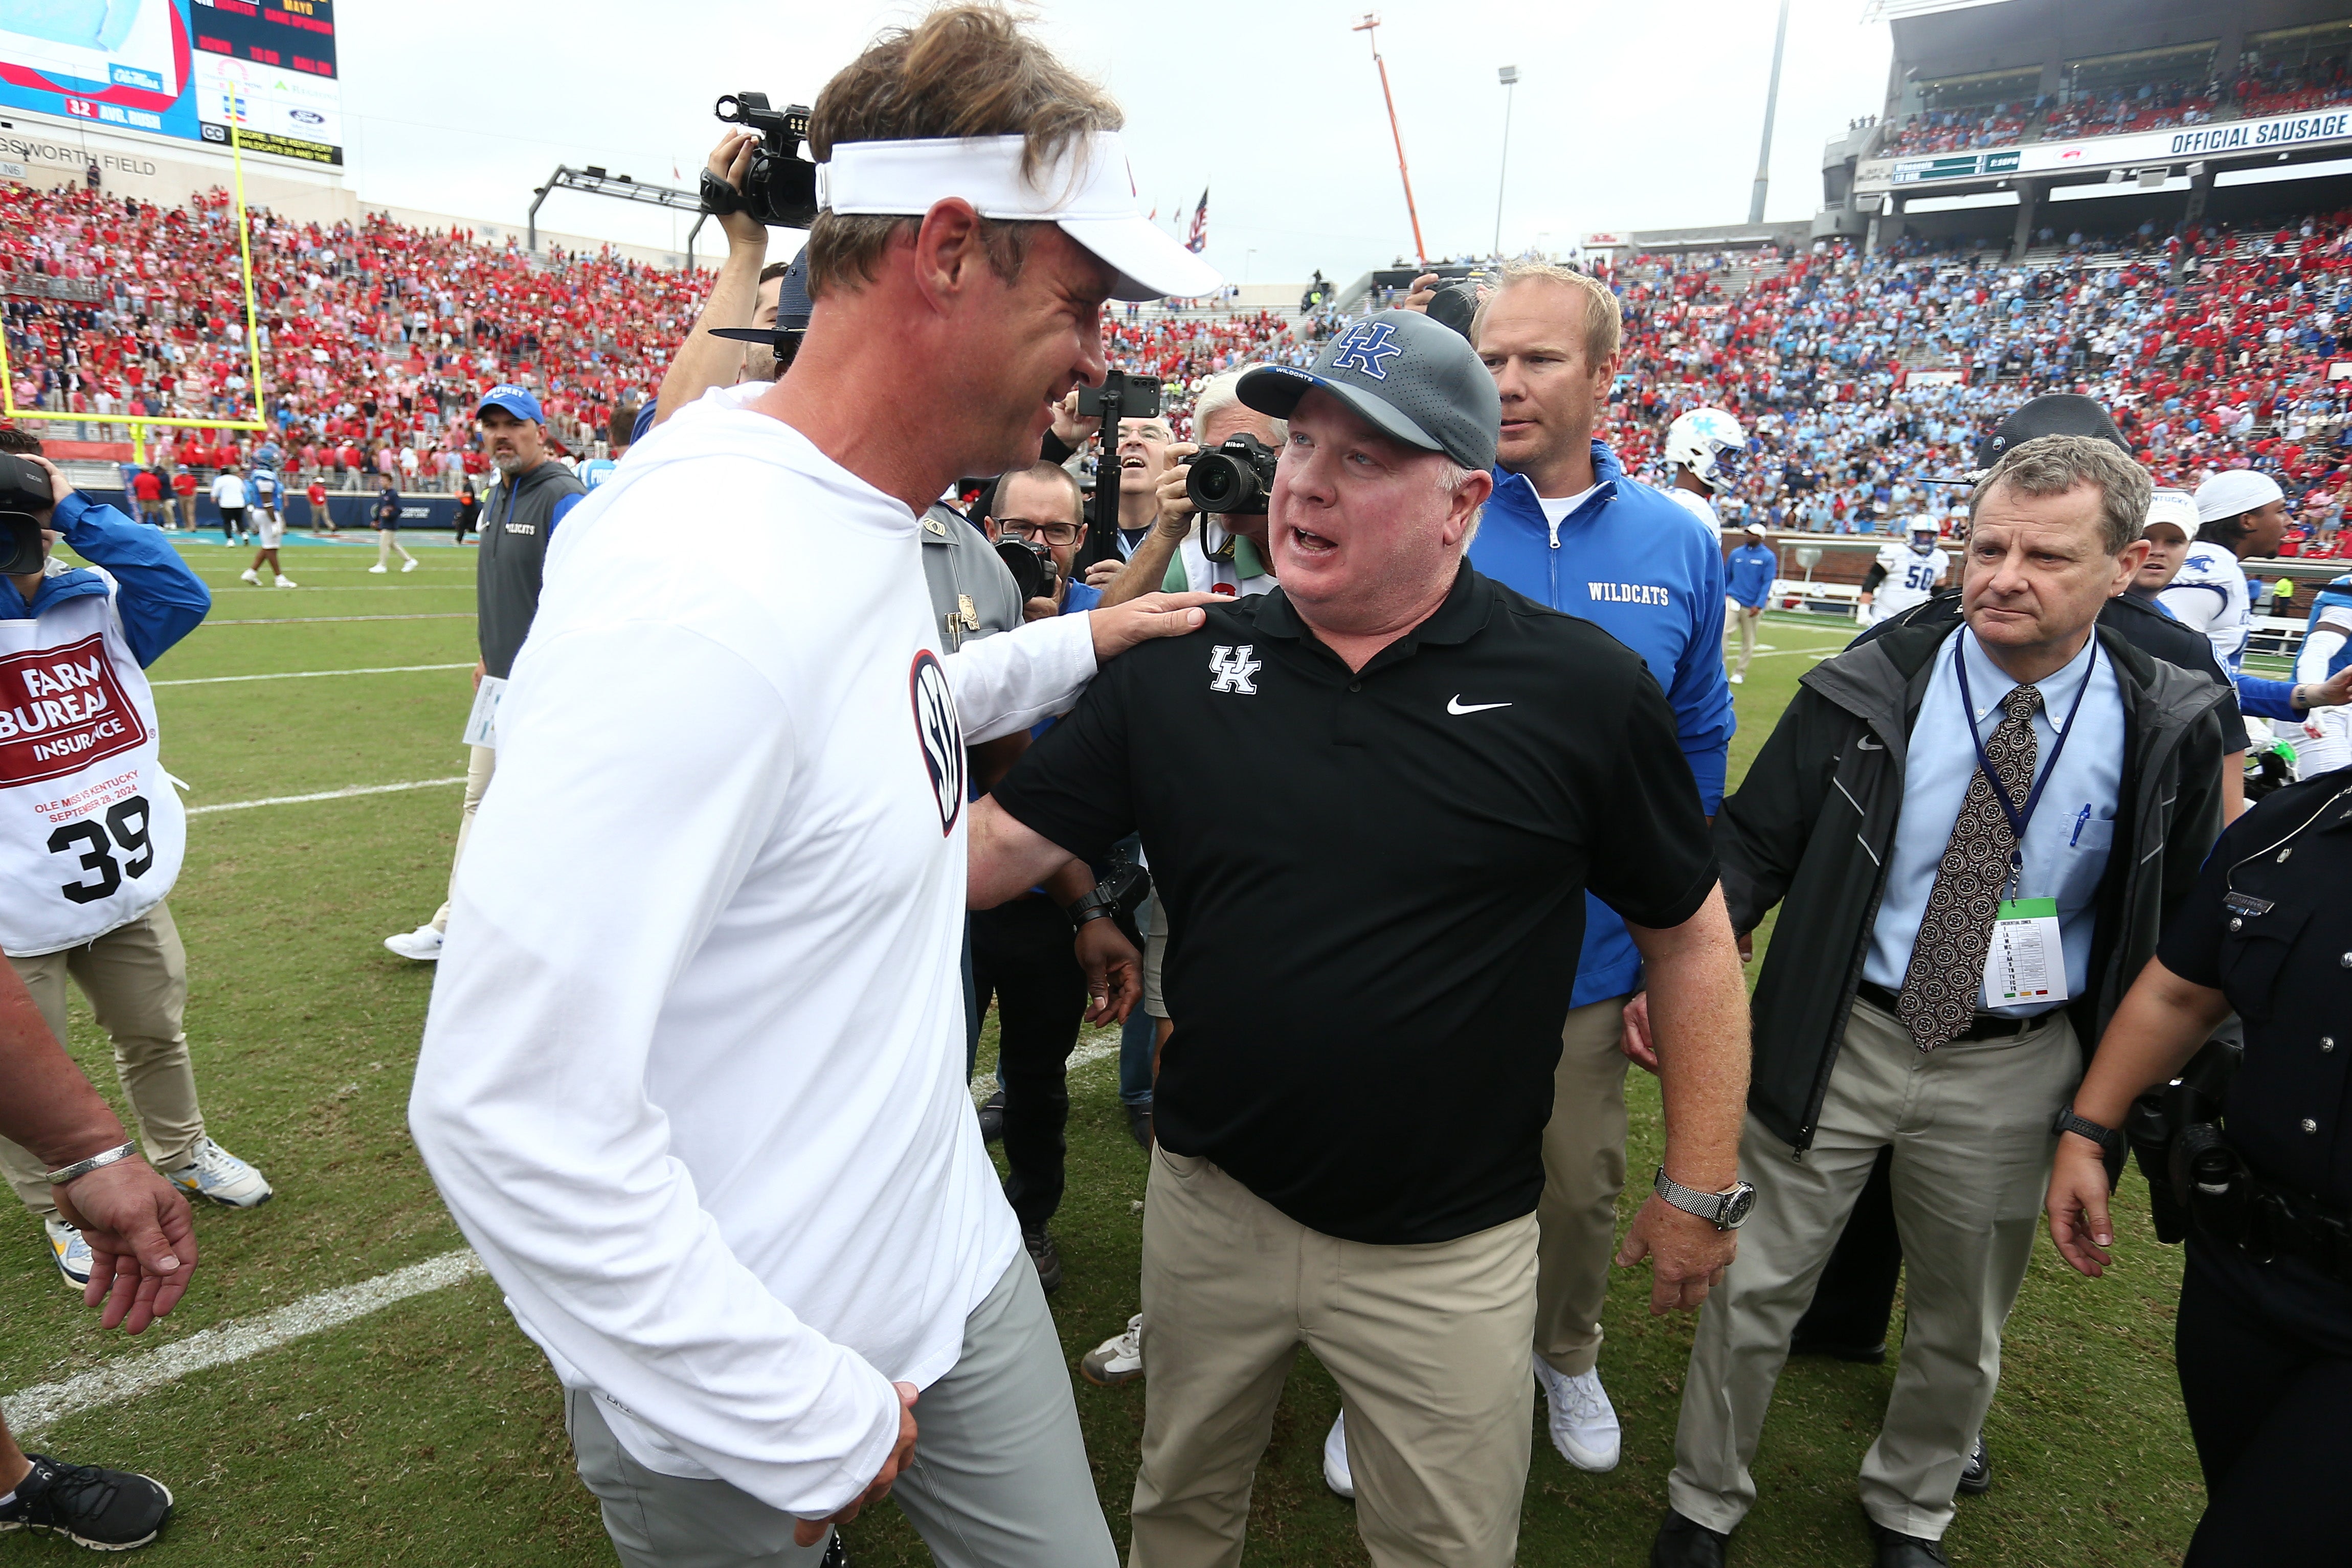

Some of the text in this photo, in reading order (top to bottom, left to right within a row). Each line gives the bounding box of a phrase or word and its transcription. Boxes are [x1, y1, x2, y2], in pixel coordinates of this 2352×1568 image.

[205, 127, 222, 139] CC
[2171, 114, 2349, 153] OFFICIAL SAUSAGE
[104, 155, 156, 176] FIELD
[1275, 367, 1314, 383] WILDCATS
[2153, 495, 2188, 507] NTUCKY
[505, 523, 535, 535] WILDCATS
[1905, 565, 1934, 591] 50
[1588, 581, 1669, 607] WILDCATS
[21, 655, 101, 698] FARM
[34, 769, 139, 814] OLE MISS VS KENTUCKY
[49, 799, 101, 823] SEPTEMBER
[114, 783, 138, 799] 2024
[47, 795, 154, 904] 39
